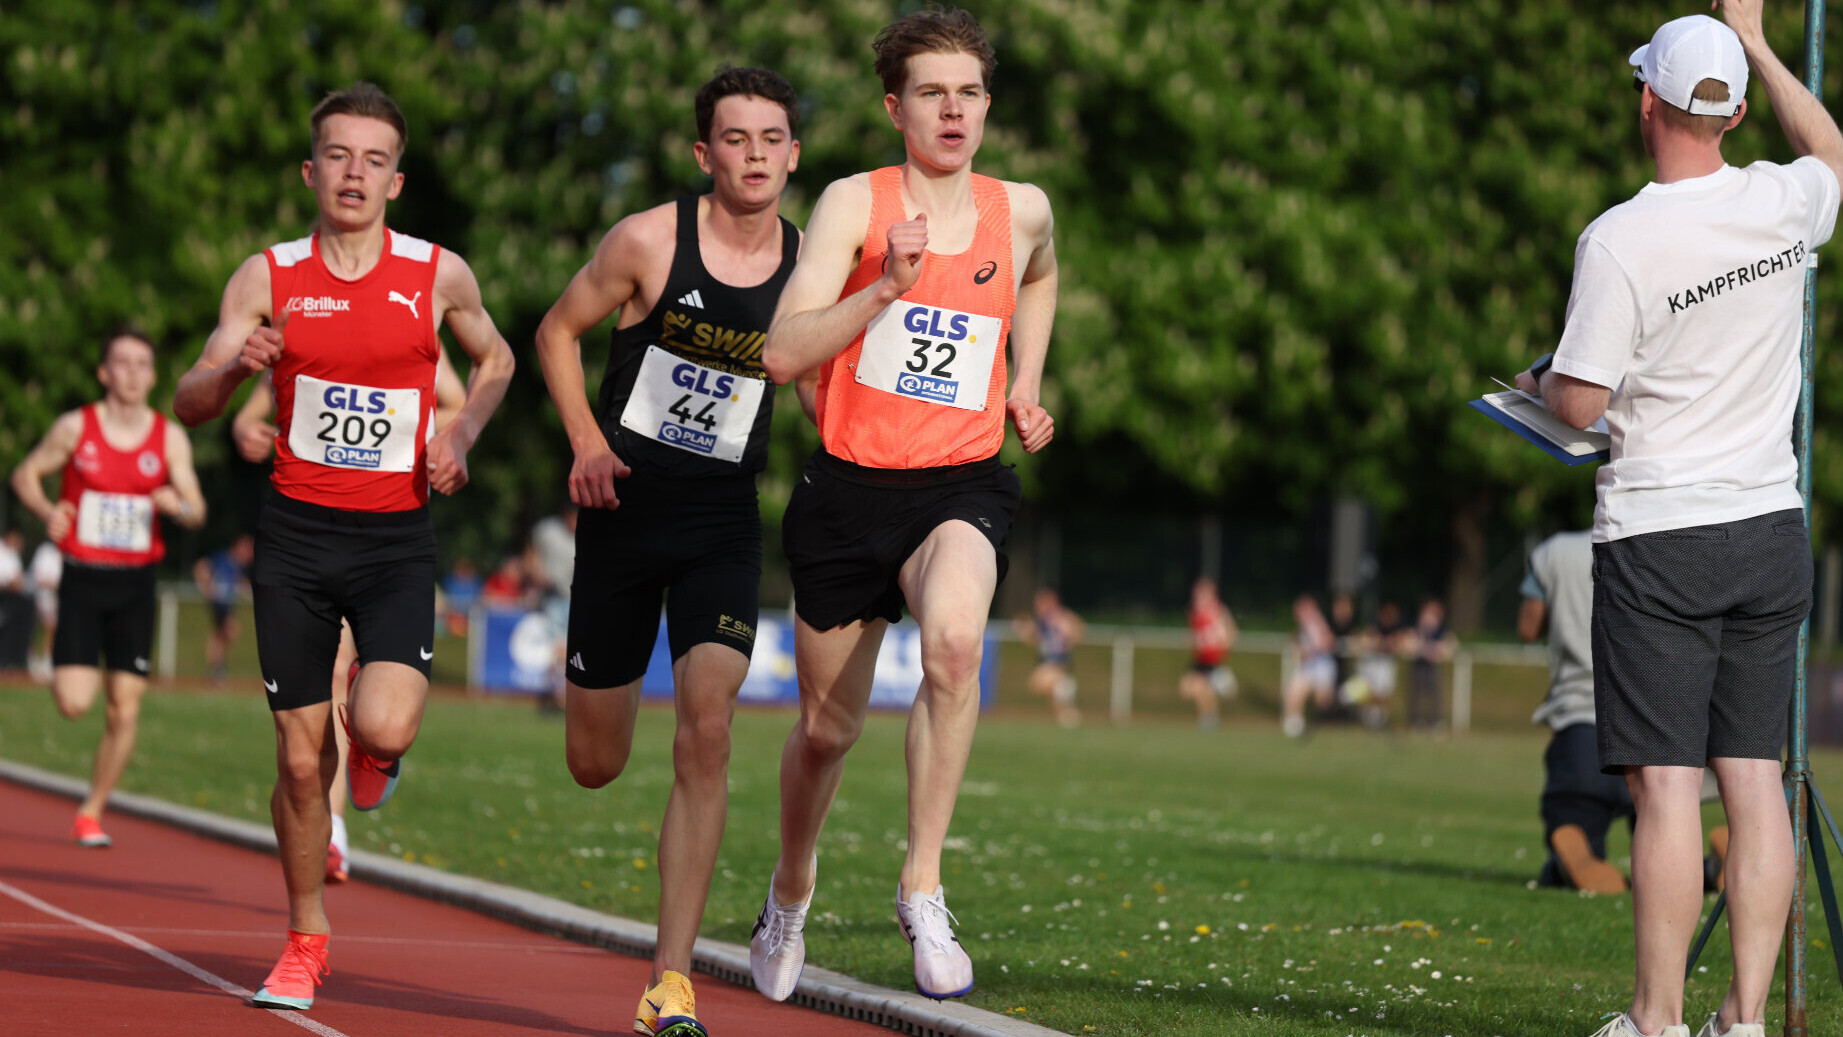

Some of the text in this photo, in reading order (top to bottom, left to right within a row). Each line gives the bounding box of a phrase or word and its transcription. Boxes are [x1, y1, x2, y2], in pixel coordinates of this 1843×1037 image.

[1667, 240, 1806, 314] KAMPFRICHTER
[303, 296, 350, 311] Brillux
[905, 337, 957, 379] 32
[921, 380, 956, 396] PLAN
[668, 394, 717, 432] 44
[316, 411, 392, 448] 209
[682, 431, 714, 447] PLAN
[347, 449, 380, 462] PLAN
